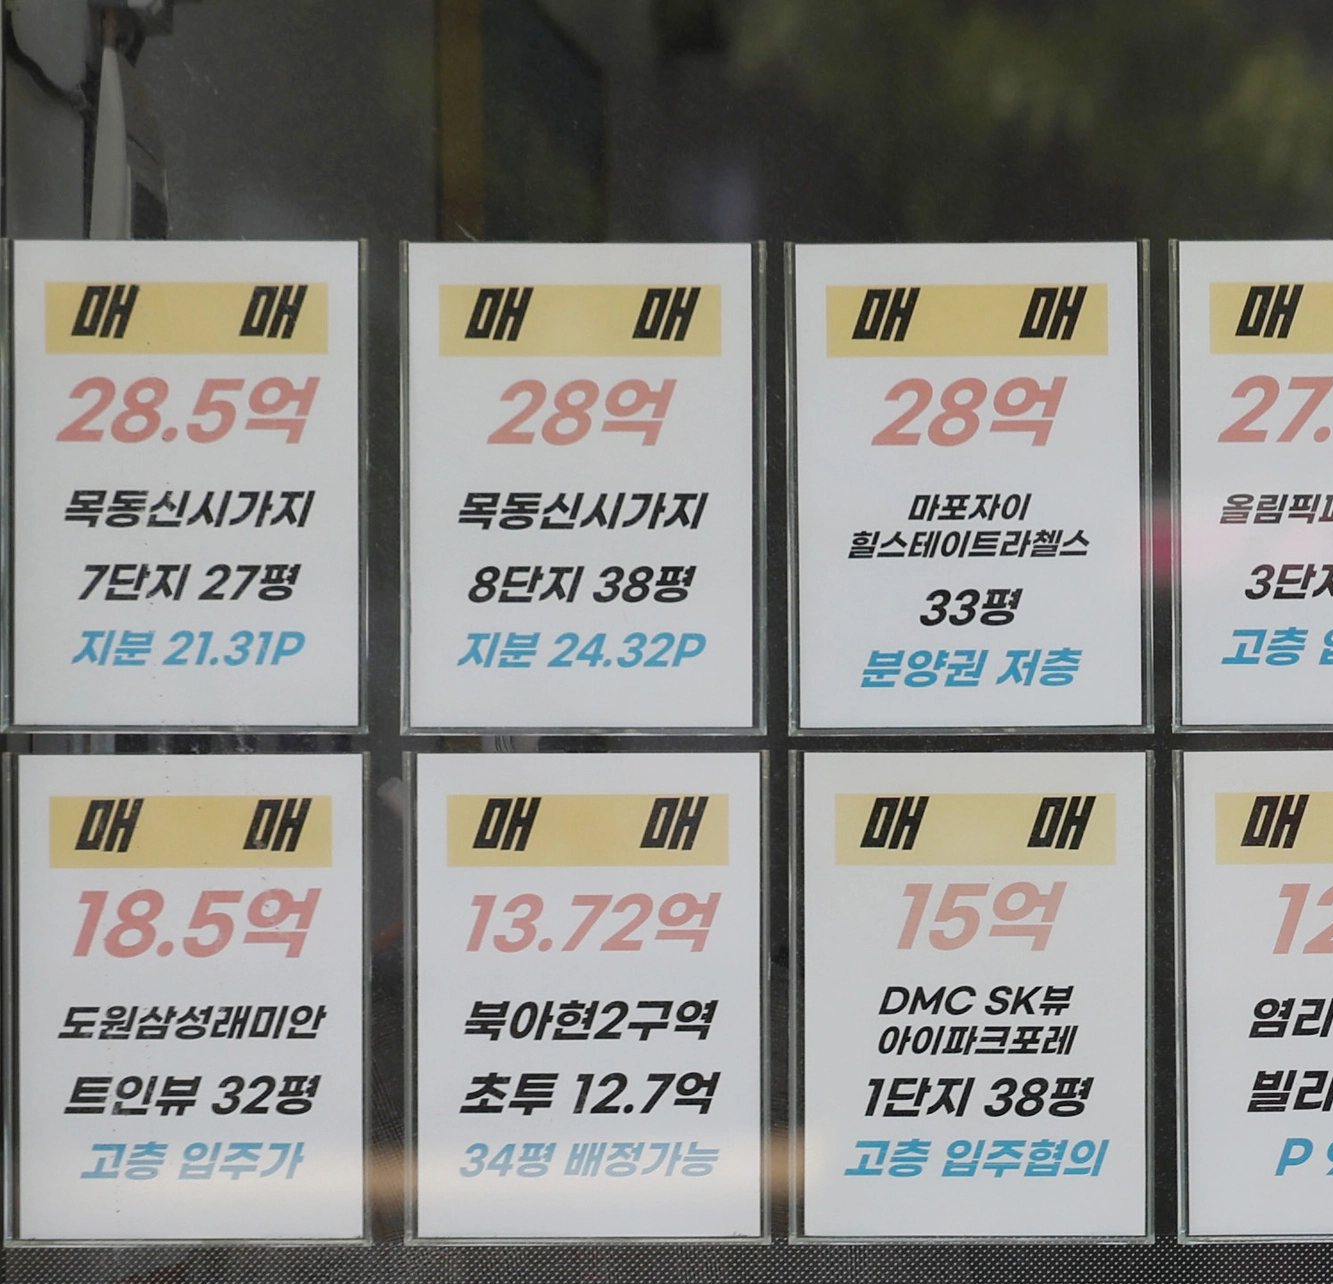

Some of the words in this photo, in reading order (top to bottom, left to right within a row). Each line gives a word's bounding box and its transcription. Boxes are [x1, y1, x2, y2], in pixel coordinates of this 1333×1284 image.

[72, 285, 139, 338] 매
[240, 286, 307, 338] 매
[465, 288, 533, 341] 매
[633, 288, 700, 341] 매
[852, 288, 920, 341] 매
[1019, 287, 1087, 340] 매
[1236, 285, 1303, 338] 매
[56, 377, 320, 443] 28.5억
[487, 379, 677, 446] 28억
[872, 377, 1068, 447] 28억
[65, 490, 315, 527] 목동신시가지
[458, 493, 709, 530] 목동신시가지
[908, 493, 1031, 521] 마포자이
[848, 530, 1089, 558] 힐스테이트라첼스
[79, 564, 191, 600] 7단지
[198, 564, 301, 601] 27평
[468, 566, 584, 603] 8단지
[593, 566, 696, 603] 38평
[920, 589, 1023, 626] 33평
[72, 630, 154, 666] 지분
[163, 630, 305, 666] 21.31P
[457, 632, 540, 668] 지분
[548, 632, 706, 668] 24.32P
[1222, 627, 1308, 666] 고층
[861, 650, 988, 687] 분양권
[996, 648, 1082, 686] 저층
[76, 799, 143, 852] 매
[244, 799, 311, 851] 매
[473, 798, 541, 851] 매
[641, 797, 708, 850] 매
[860, 797, 929, 850] 매
[1028, 796, 1096, 849] 매
[1241, 795, 1309, 848] 매
[73, 888, 321, 958] 18.5억
[467, 893, 721, 952] 13.72억
[898, 882, 1067, 951] 15억
[879, 986, 976, 1015] DMC
[985, 986, 1074, 1015] SK뷰
[58, 1005, 327, 1039] 도원삼성래미안
[464, 1000, 718, 1041] 북아현2구역
[879, 1026, 1078, 1055] 아이파크포레
[64, 1076, 202, 1116] 트인뷰
[212, 1075, 321, 1115] 32평
[460, 1072, 559, 1115] 초투
[573, 1072, 721, 1114] 12.7억
[865, 1078, 975, 1117] 1단지
[984, 1077, 1094, 1117] 38평
[81, 1141, 168, 1179] 고층
[182, 1142, 304, 1178] 입주가
[460, 1142, 557, 1177] 34평
[565, 1142, 719, 1176] 배정가능
[845, 1139, 931, 1177] 고층
[942, 1139, 1109, 1177] 입주협의
[1275, 1138, 1313, 1176] P
